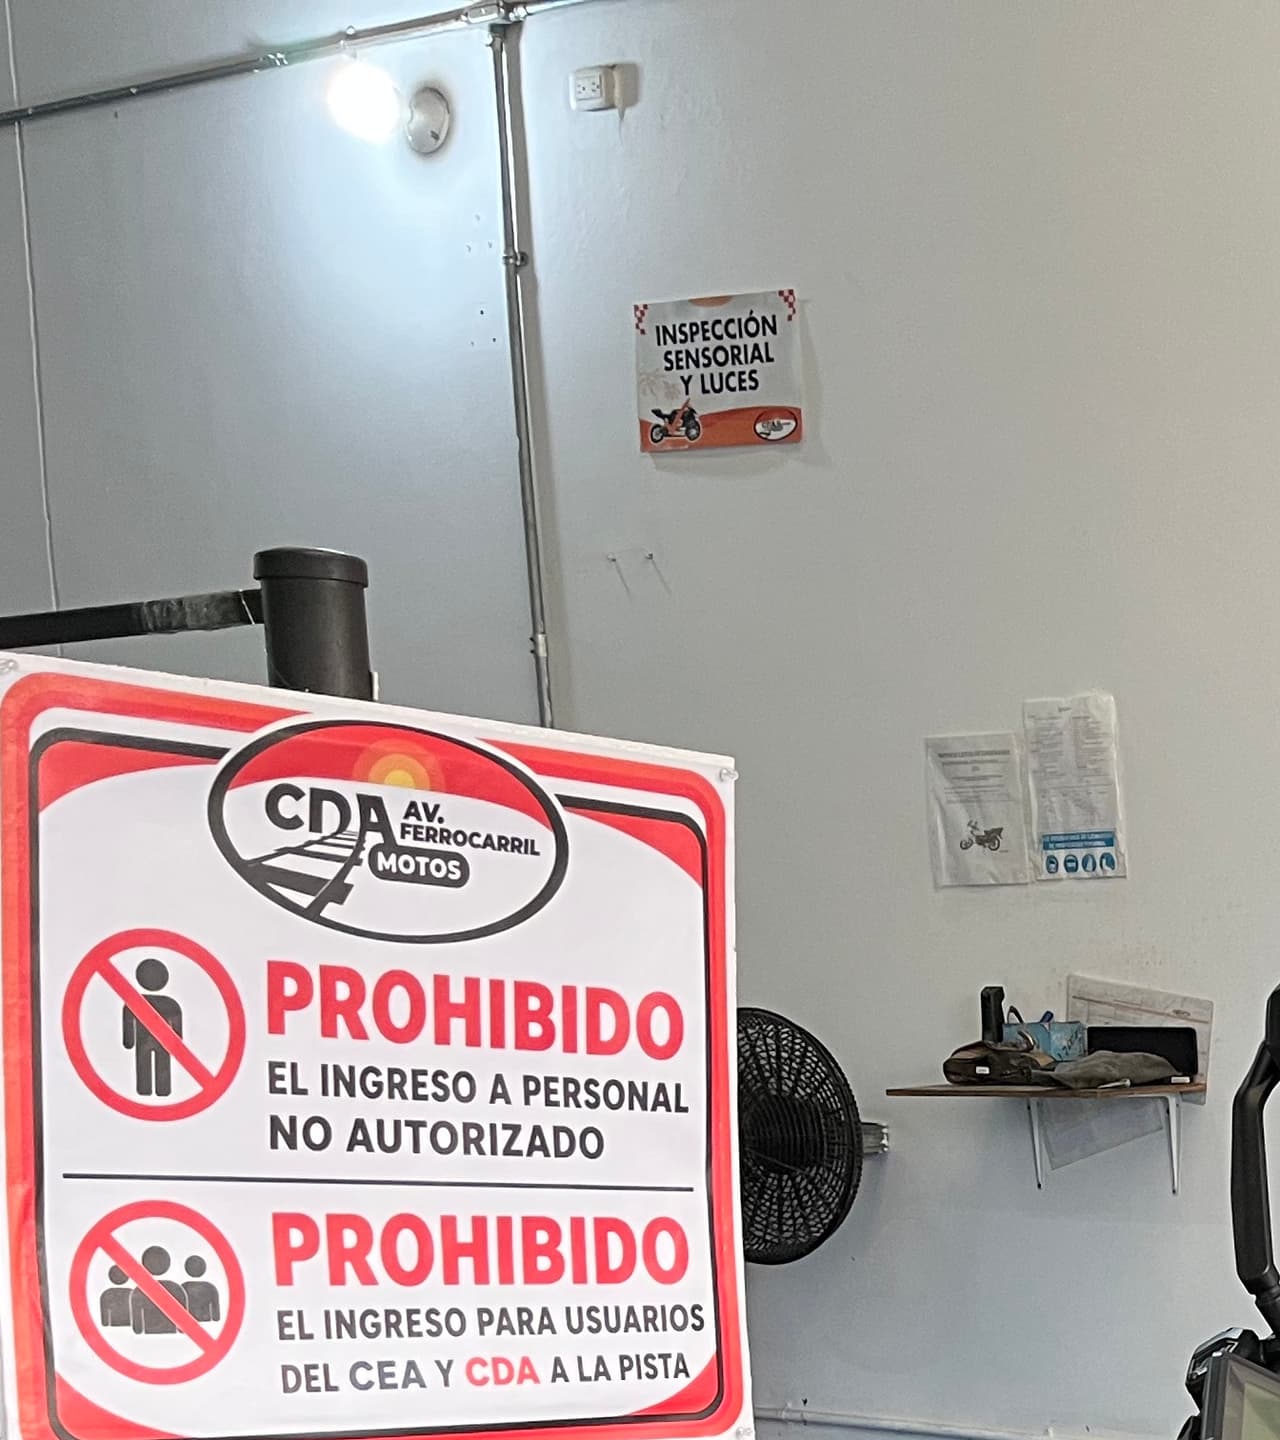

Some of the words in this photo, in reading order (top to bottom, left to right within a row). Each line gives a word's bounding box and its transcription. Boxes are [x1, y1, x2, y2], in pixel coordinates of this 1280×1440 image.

[655, 309, 778, 346] INSPECCIÓN
[663, 342, 774, 371] SENSORIAL
[680, 375, 693, 396] Y
[700, 369, 759, 395] LUCES
[266, 781, 397, 843] CDA
[403, 801, 446, 824] AV.
[400, 823, 540, 857] FERROCARRIL
[377, 853, 462, 881] MOTOS
[267, 961, 685, 1060] PROHIBIDO
[268, 1062, 311, 1098] EL
[321, 1065, 477, 1105] INGRESO
[489, 1075, 512, 1106] A
[523, 1076, 690, 1114] PERSONAL
[269, 1116, 332, 1152] NO
[346, 1117, 605, 1160] AUTORIZADO
[272, 1212, 691, 1287] PROHIBIDO
[278, 1309, 315, 1341] EL
[324, 1307, 467, 1340] INGRESO
[477, 1306, 557, 1337] PARA
[565, 1303, 705, 1336] USUARIOS
[282, 1361, 339, 1394] DEL
[349, 1358, 427, 1391] CEA
[435, 1358, 455, 1388] Y
[465, 1355, 540, 1387] CDA
[551, 1357, 570, 1384] A
[578, 1355, 612, 1382] LA
[619, 1352, 691, 1382] PISTA
